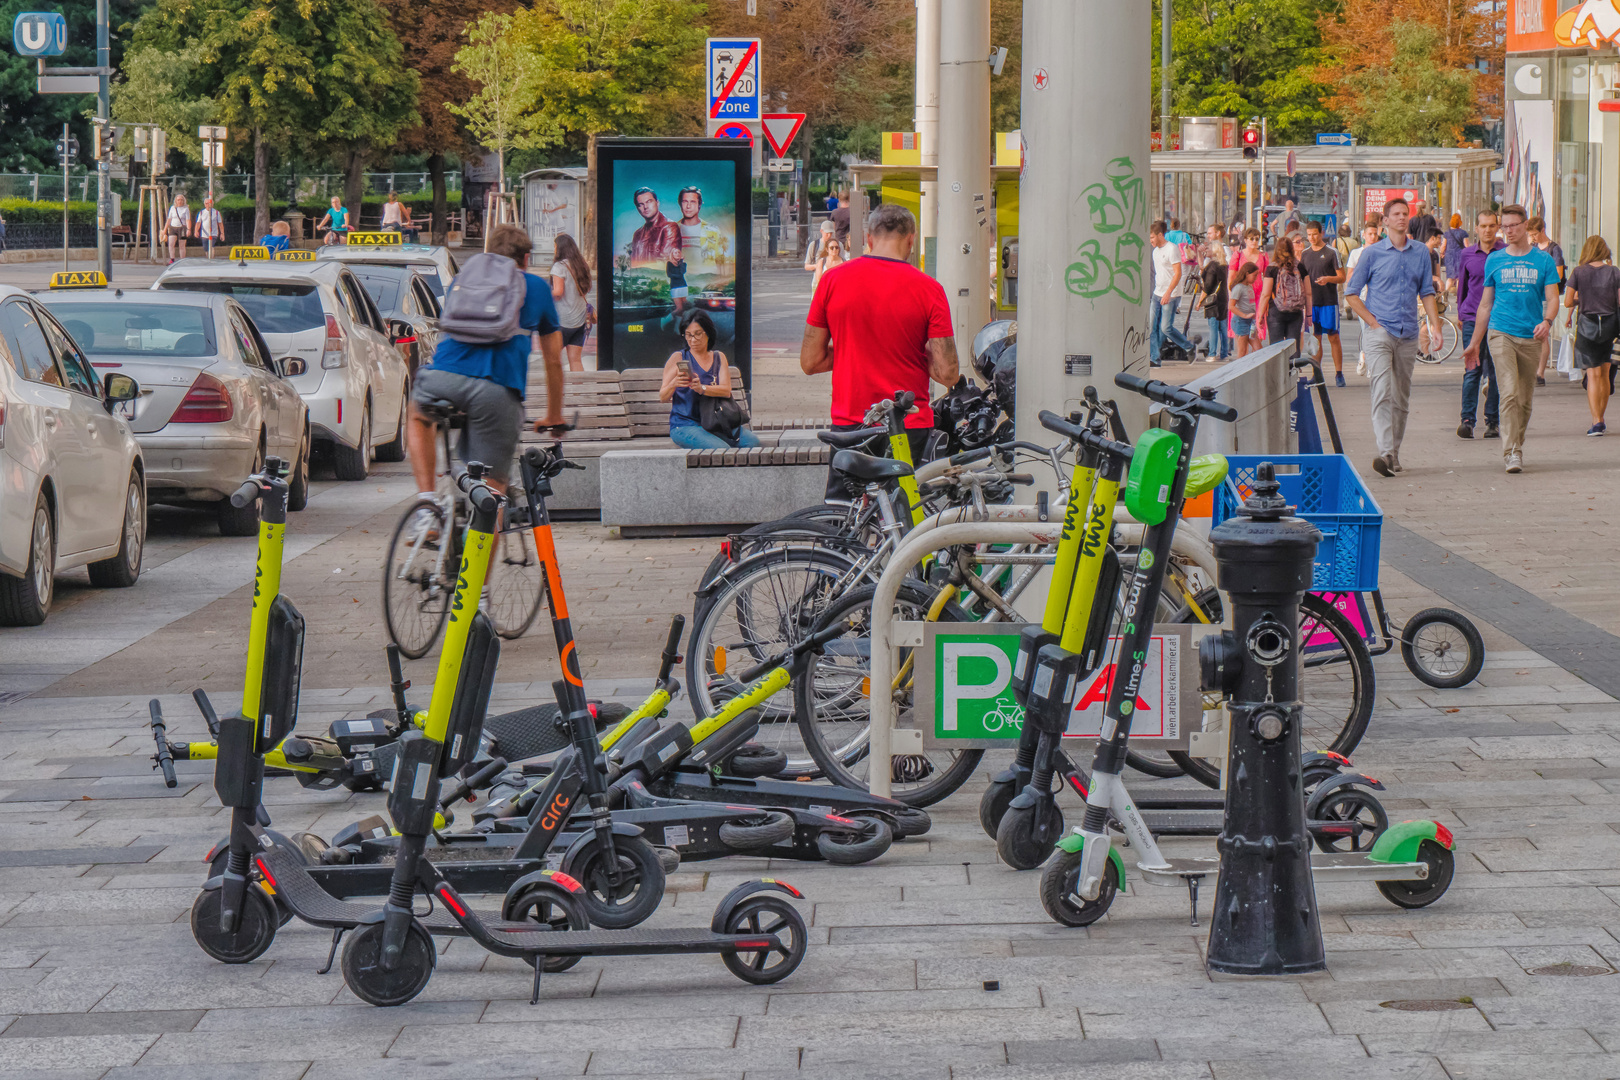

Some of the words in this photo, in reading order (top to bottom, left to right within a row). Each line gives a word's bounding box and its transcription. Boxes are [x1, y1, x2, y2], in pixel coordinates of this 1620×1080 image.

[22, 22, 46, 50] U
[56, 22, 66, 51] U
[738, 79, 752, 93] 20
[718, 100, 750, 113] Zone
[353, 235, 394, 244] TAXI
[237, 249, 263, 258] TAXI
[283, 252, 308, 260] TAXI
[60, 272, 97, 284] TAXI
[1501, 268, 1515, 279] TOM
[1515, 268, 1539, 280] TAILOR
[628, 325, 644, 333] ONCE
[943, 642, 1012, 730] P
[1167, 637, 1177, 738] wien.arbeiterkammer.at
[541, 793, 570, 831] circ
